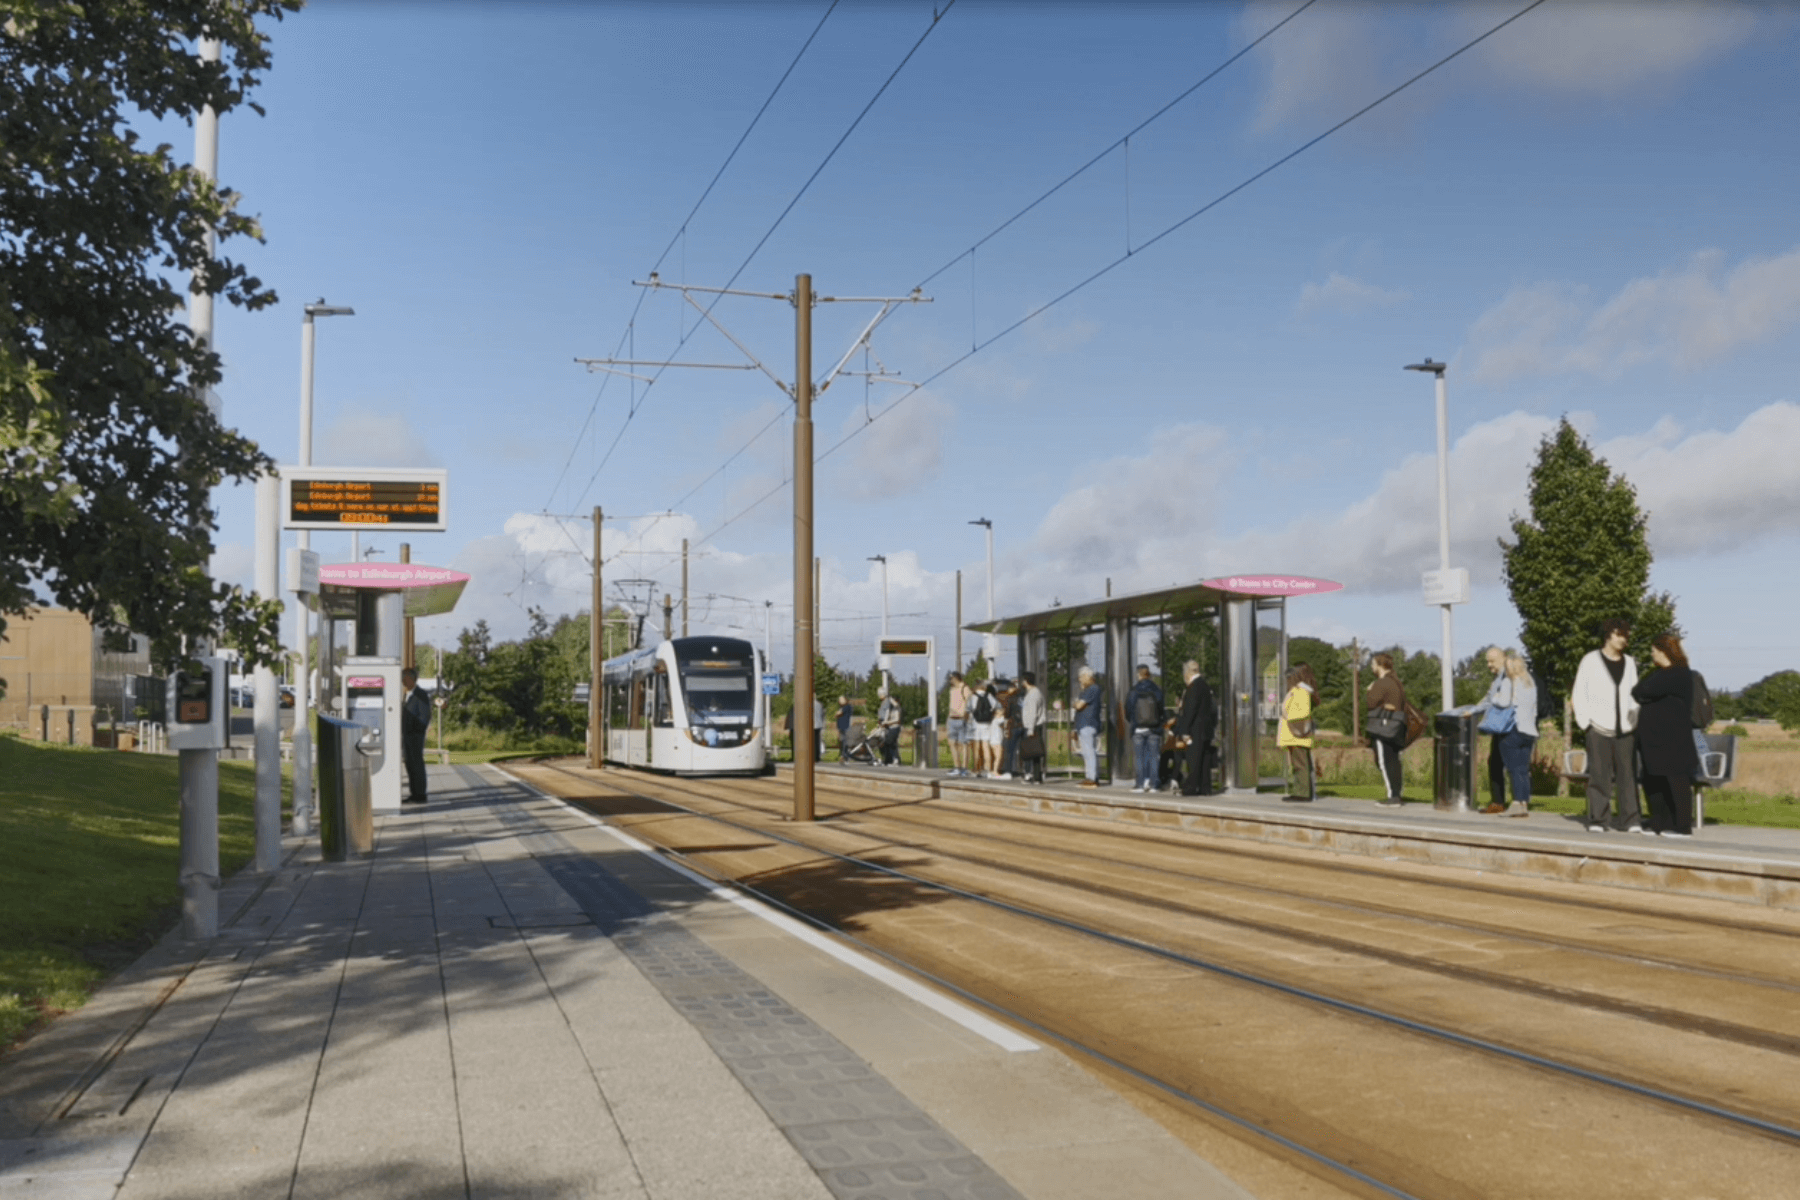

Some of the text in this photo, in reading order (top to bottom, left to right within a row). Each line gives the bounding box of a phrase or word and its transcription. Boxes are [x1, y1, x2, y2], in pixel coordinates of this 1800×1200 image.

[348, 569, 359, 579] to
[362, 568, 413, 581] Edinburgh
[415, 569, 451, 580] Airport
[1272, 578, 1288, 590] City
